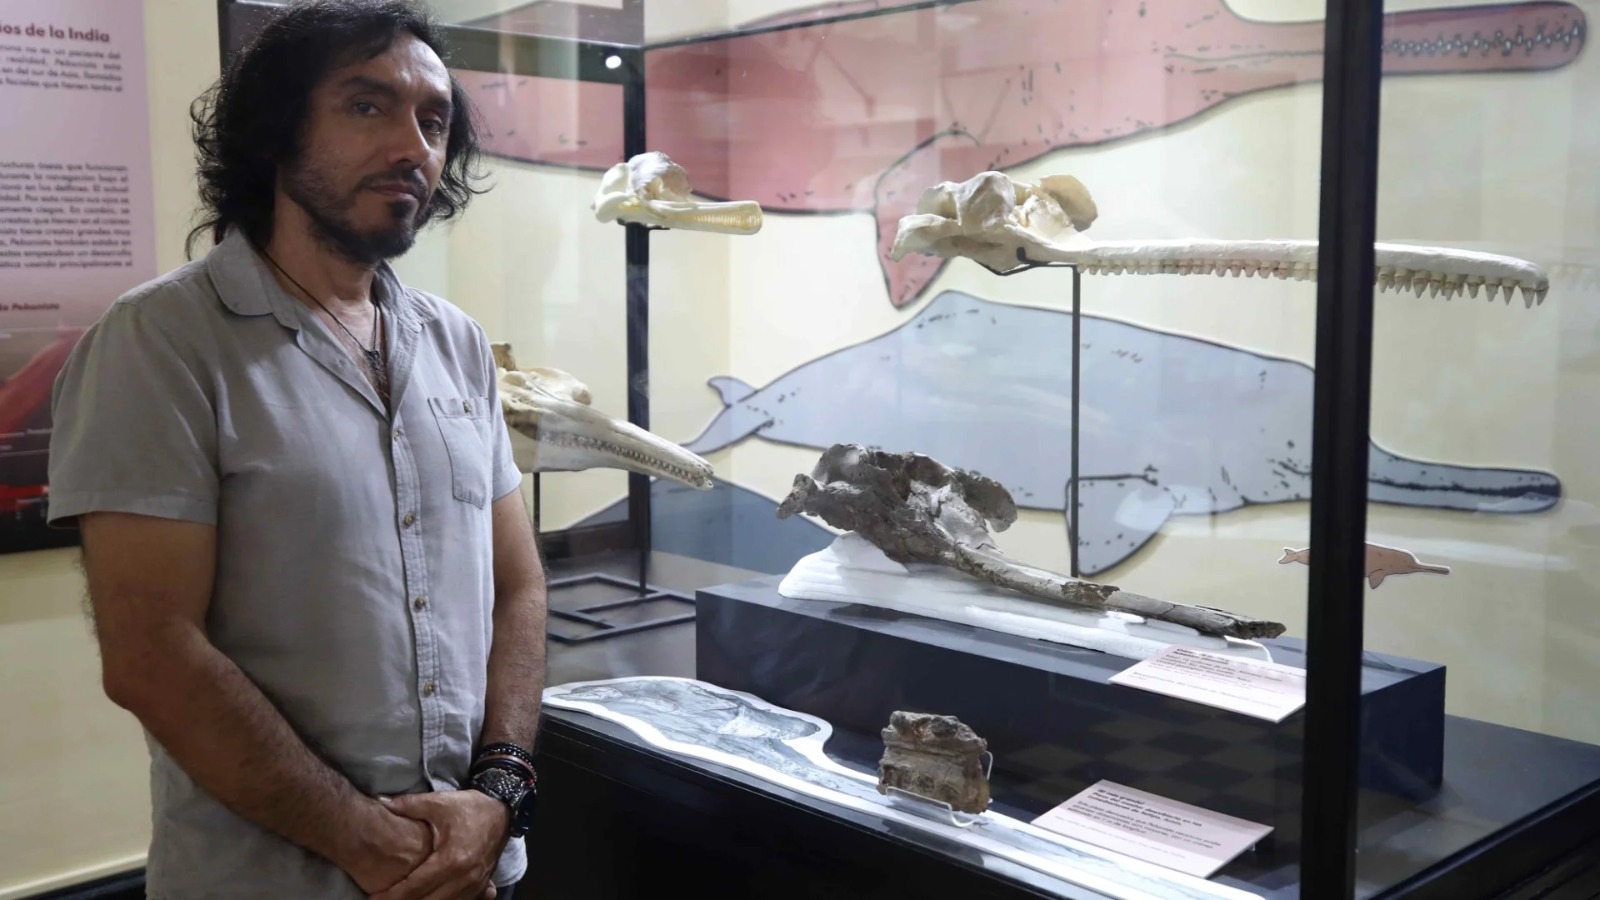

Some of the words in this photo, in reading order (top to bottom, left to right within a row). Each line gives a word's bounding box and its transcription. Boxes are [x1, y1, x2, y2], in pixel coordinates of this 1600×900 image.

[25, 22, 46, 36] de
[49, 24, 65, 39] la
[68, 26, 110, 42] India
